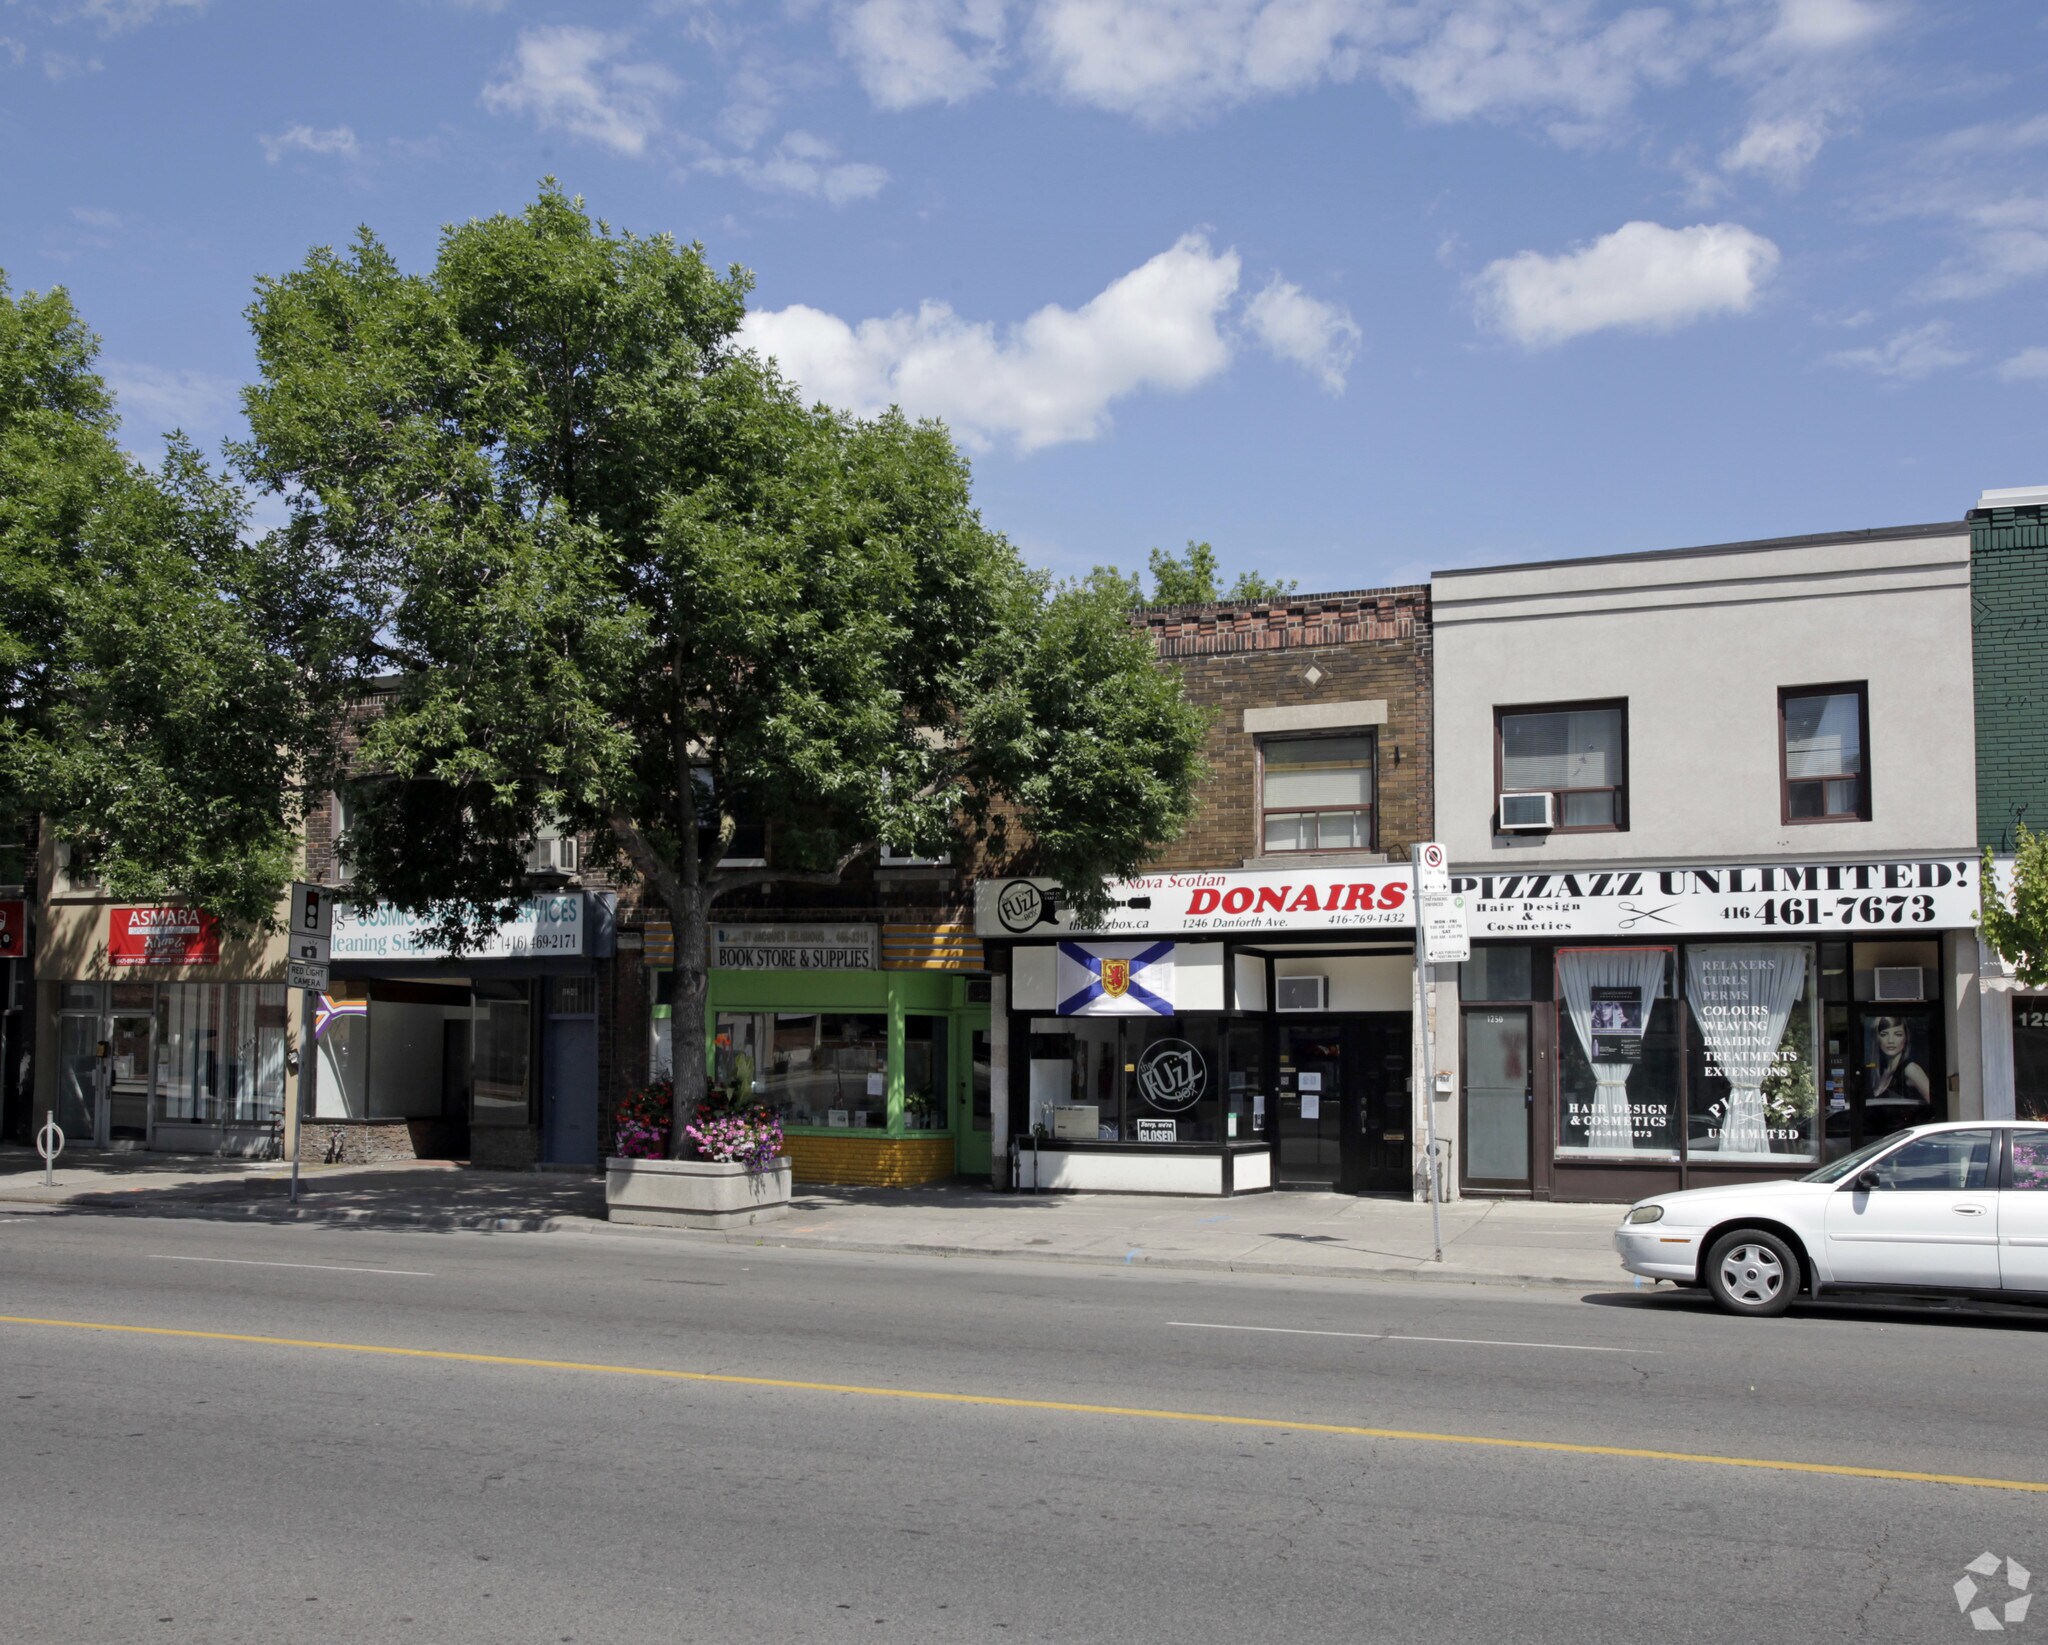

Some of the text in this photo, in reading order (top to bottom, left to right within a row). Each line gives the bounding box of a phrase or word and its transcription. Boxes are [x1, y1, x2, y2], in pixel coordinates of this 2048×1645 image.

[1126, 877, 1163, 890] Nova
[1168, 872, 1226, 888] Scotian
[1451, 872, 1643, 900] PIZZAZZ
[1657, 862, 1968, 896] UNLIMITED!
[1185, 882, 1408, 915] DONAIRS
[506, 898, 577, 923] ERVICES
[1476, 901, 1581, 913] Hair Design
[1720, 894, 1936, 926] 416 461-7673
[128, 910, 200, 926] ASMARA
[1182, 917, 1288, 929] 1246 Danforth Ave.
[1328, 913, 1405, 925] 416-769-1432
[1522, 912, 1534, 922] &
[1487, 922, 1572, 932] Cosmetics
[332, 933, 387, 956] leaning
[501, 934, 527, 952] (416)
[530, 933, 576, 950] 469-2171
[719, 949, 869, 968] BOOK STORE & SUPPLIES
[291, 966, 324, 977] RED LIGHT
[1702, 960, 1775, 971] RELAXERS
[293, 976, 321, 987] CAMERA
[1702, 976, 1748, 986] CURLS
[1703, 991, 1749, 1001] PERMS
[1703, 1005, 1768, 1016] COLOURS
[1487, 1015, 1504, 1023] 1250
[1703, 1020, 1767, 1031] WEAVING
[1704, 1036, 1771, 1046] BRAIDING
[1704, 1051, 1798, 1062] TREATMENTS
[1704, 1067, 1788, 1077] EXTENSIONS
[1174, 1084, 1198, 1102] BOX
[1569, 1103, 1667, 1115] HAIR DESIGN
[1708, 1090, 1796, 1118] PIZZAZZ
[1158, 1121, 1172, 1129] we're
[1140, 1129, 1174, 1142] CLOSED
[1708, 1128, 1799, 1140] UNLIMITED
